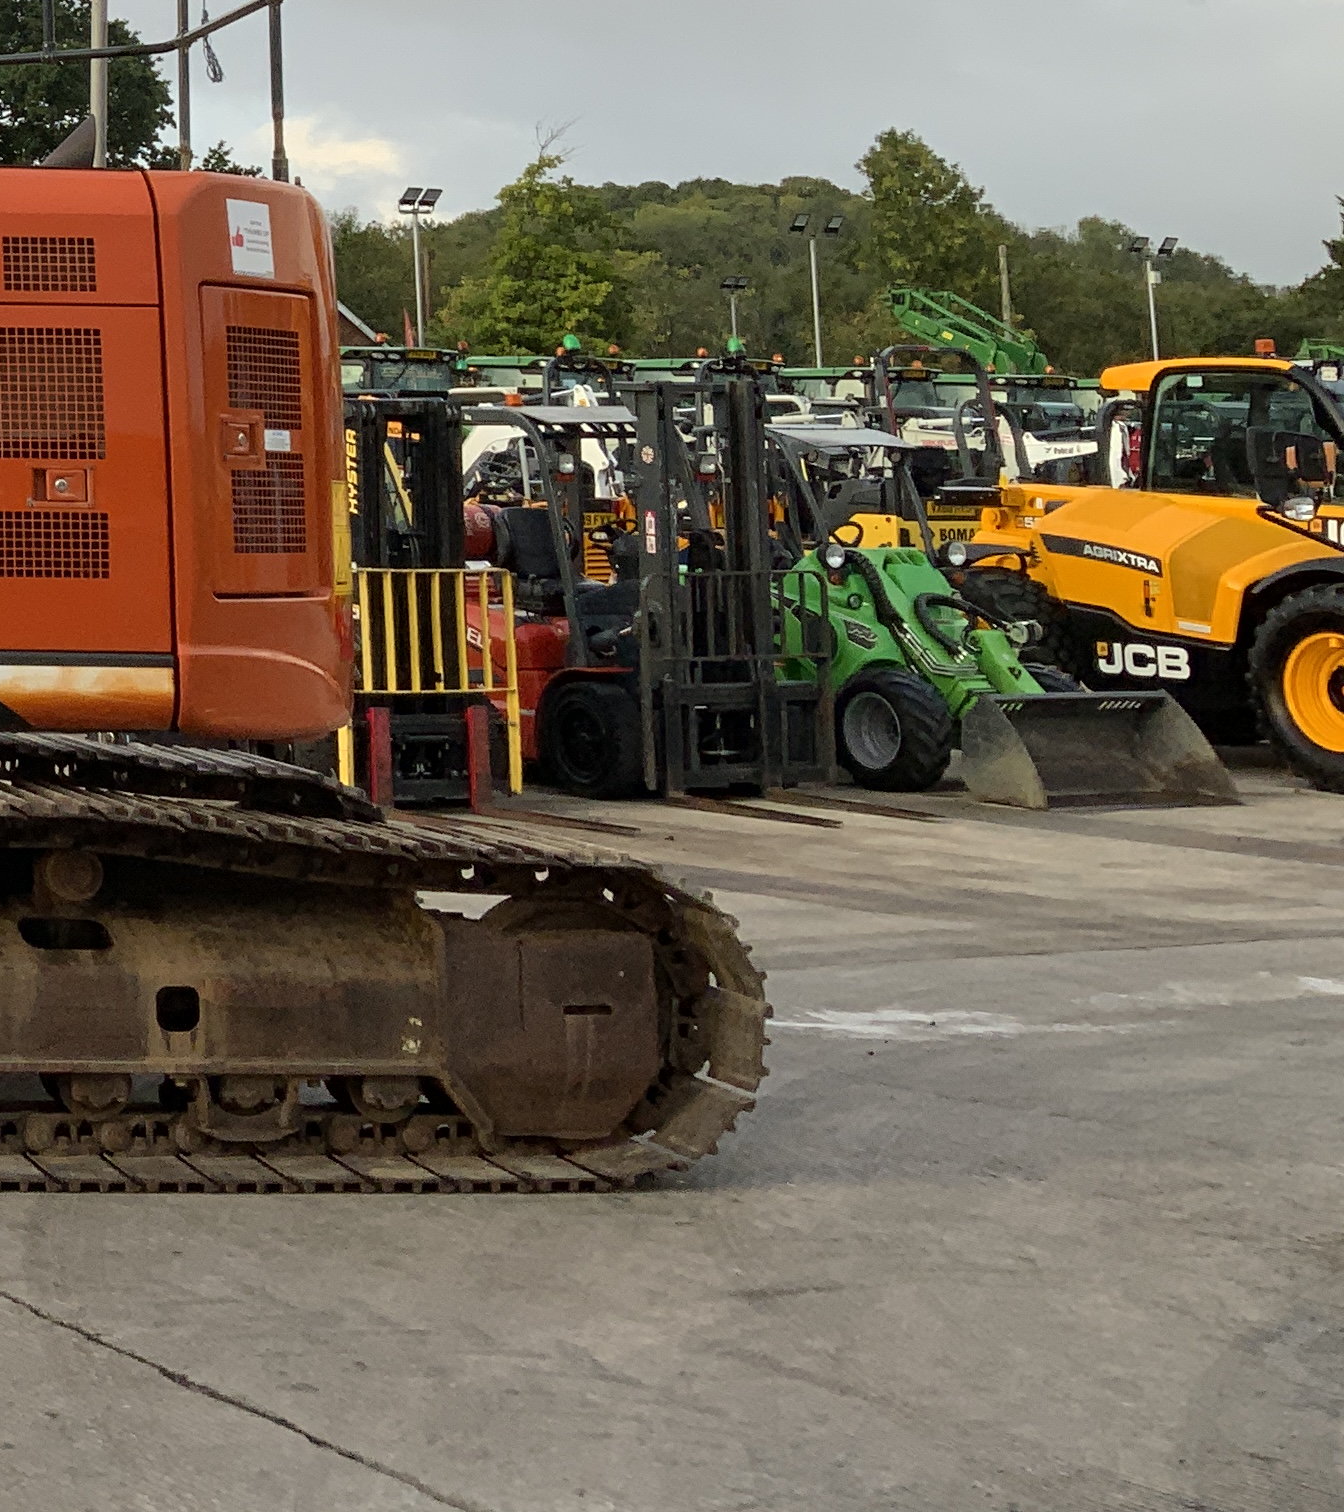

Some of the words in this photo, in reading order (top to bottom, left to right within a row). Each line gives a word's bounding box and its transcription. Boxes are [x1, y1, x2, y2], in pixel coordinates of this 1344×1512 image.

[345, 428, 359, 515] HYSTER
[939, 528, 978, 542] BOMA
[1083, 544, 1160, 573] AGRIXTRA
[1097, 642, 1191, 680] JCB
